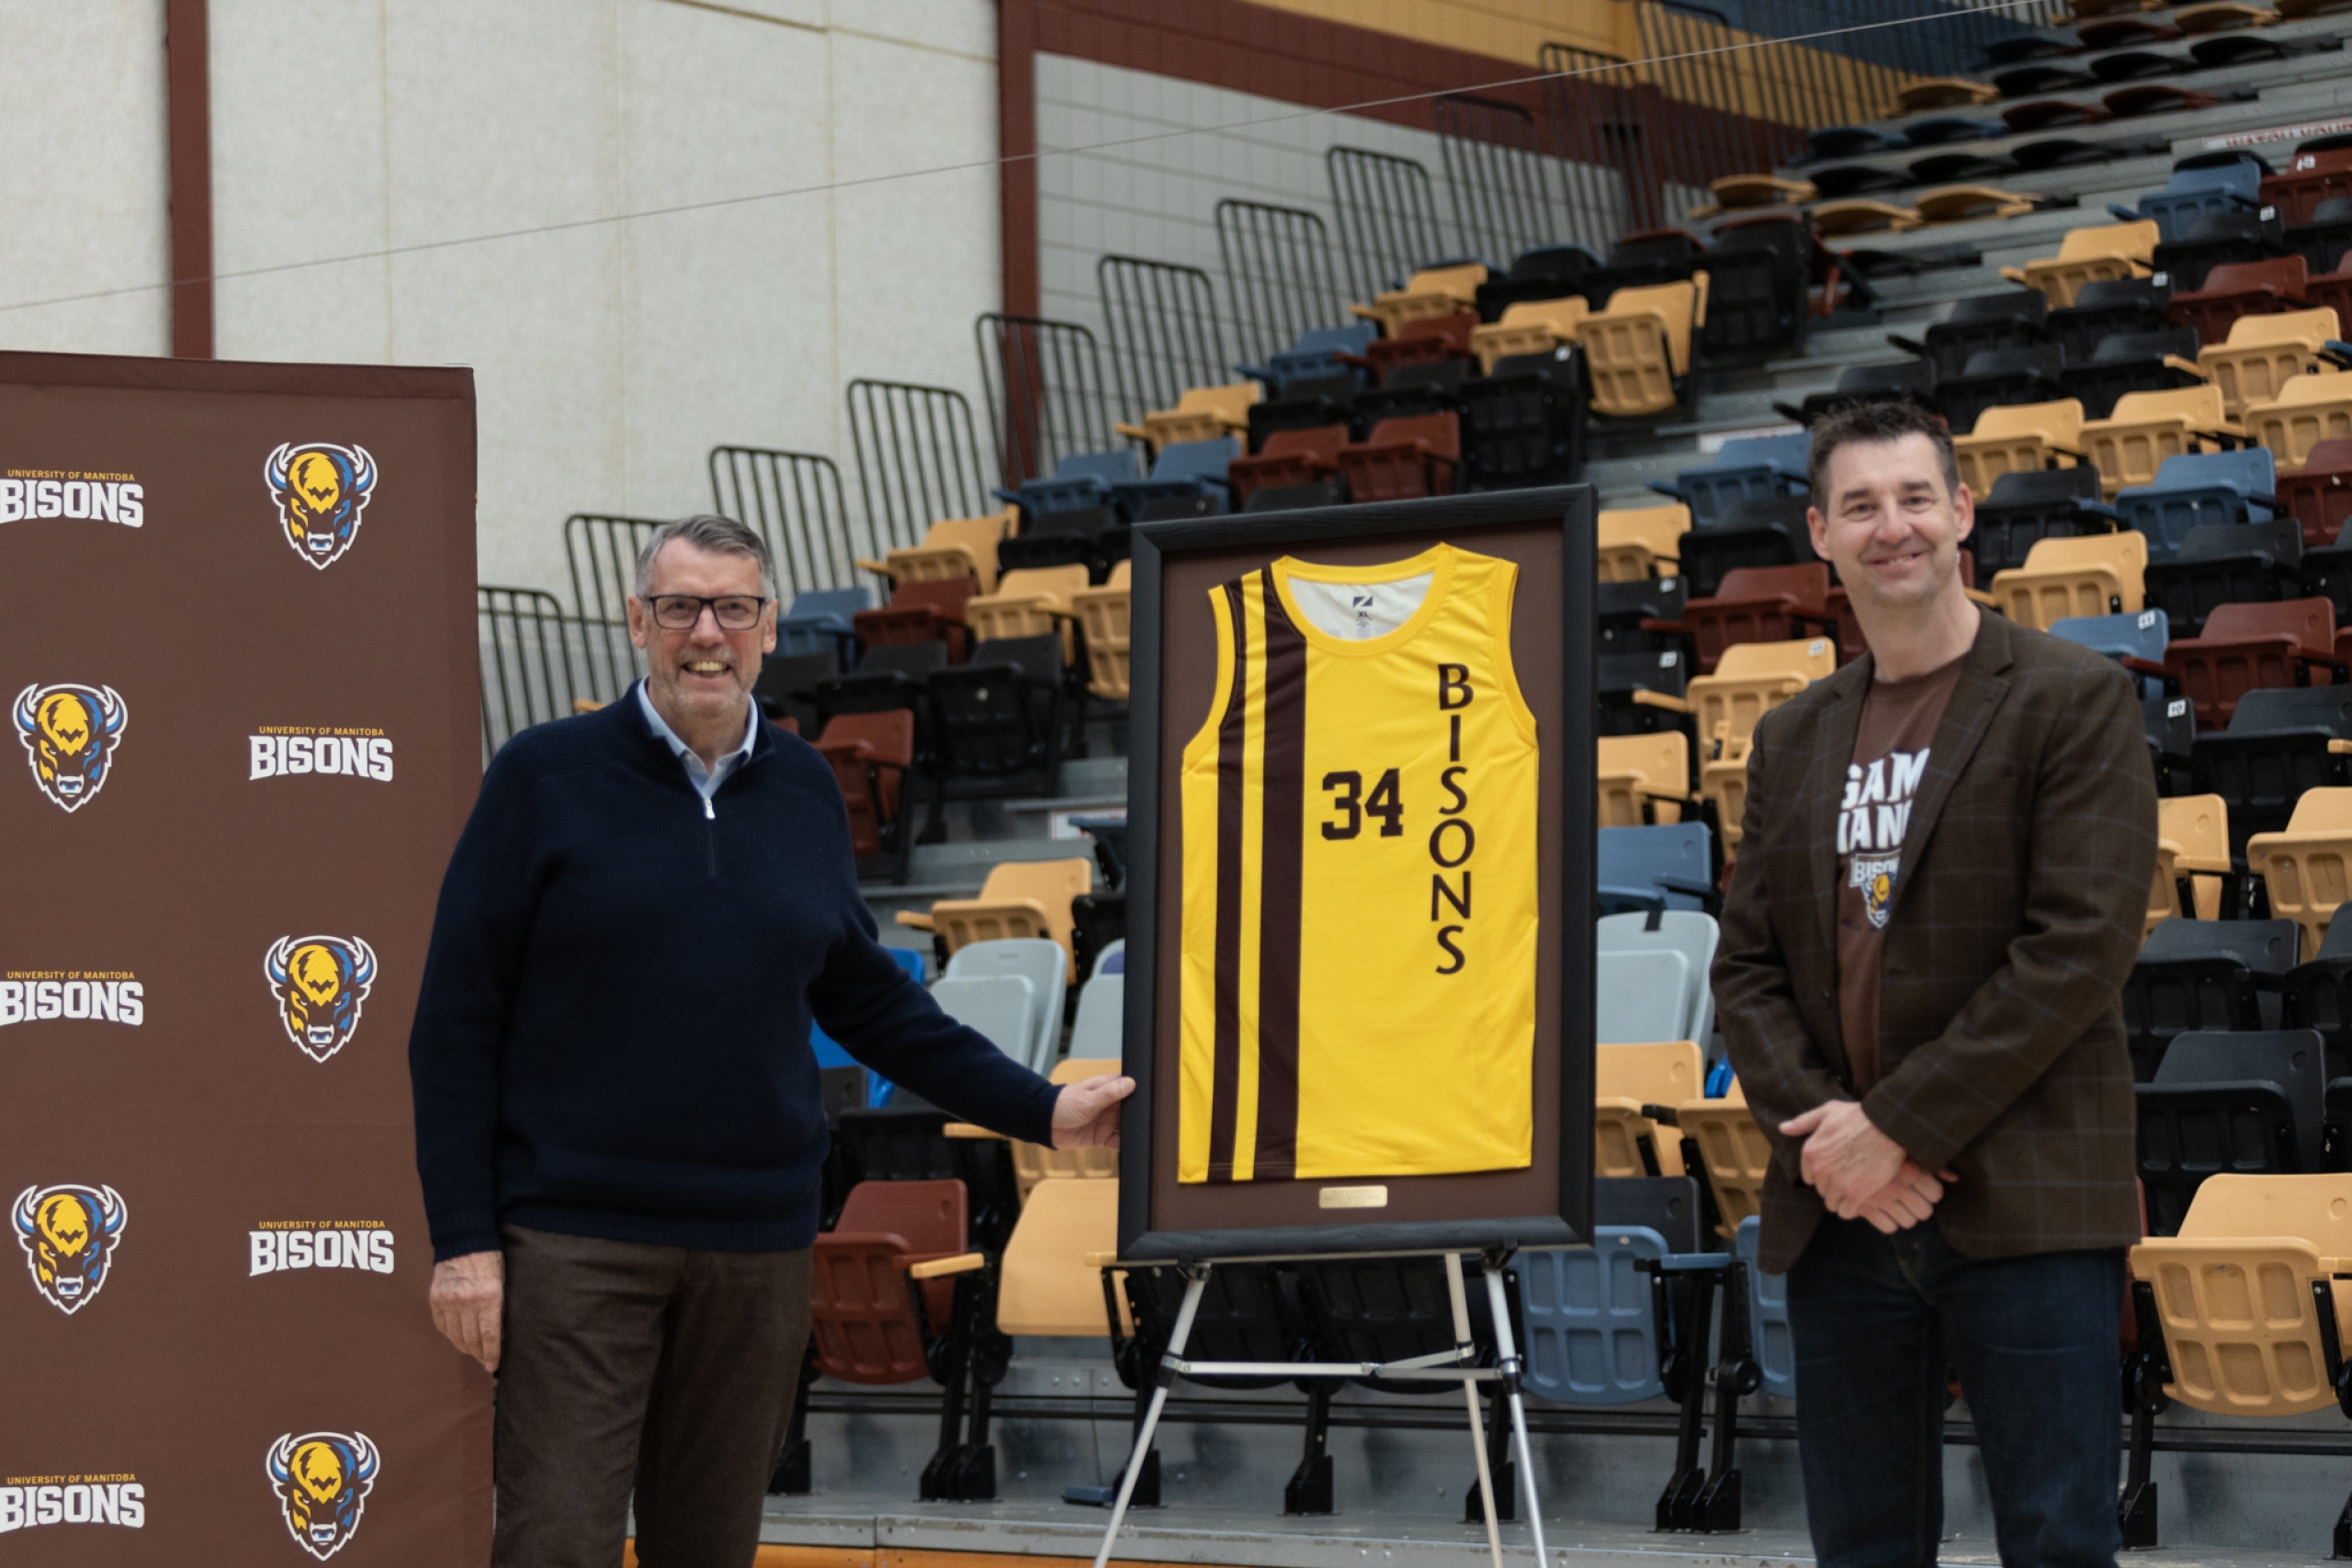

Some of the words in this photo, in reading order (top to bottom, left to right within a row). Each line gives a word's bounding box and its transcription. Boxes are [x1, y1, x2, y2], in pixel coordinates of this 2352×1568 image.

[7, 469, 65, 479] UNIVERSITY
[68, 471, 81, 479] OF
[84, 472, 135, 481] MANITOBA
[0, 479, 143, 528] BISONS
[259, 726, 316, 735] UNIVERSITY
[319, 727, 332, 736] OF
[334, 728, 385, 736] MANITOBA
[249, 735, 393, 782] BISONS
[1841, 748, 1930, 809] GAM
[1321, 769, 1404, 841] 34
[1428, 663, 1476, 975] BISONS
[7, 971, 65, 979] UNIVERSITY
[68, 971, 81, 979] OF
[84, 971, 135, 979] MANITOBA
[0, 980, 143, 1026] BISONS
[259, 1221, 316, 1229] UNIVERSITY
[319, 1221, 332, 1229] OF
[334, 1220, 385, 1229] MANITOBA
[249, 1229, 394, 1277] BISONS
[7, 1475, 65, 1484] UNIVERSITY
[68, 1474, 81, 1483] OF
[84, 1473, 136, 1483] MANITOBA
[0, 1483, 145, 1533] BISONS
